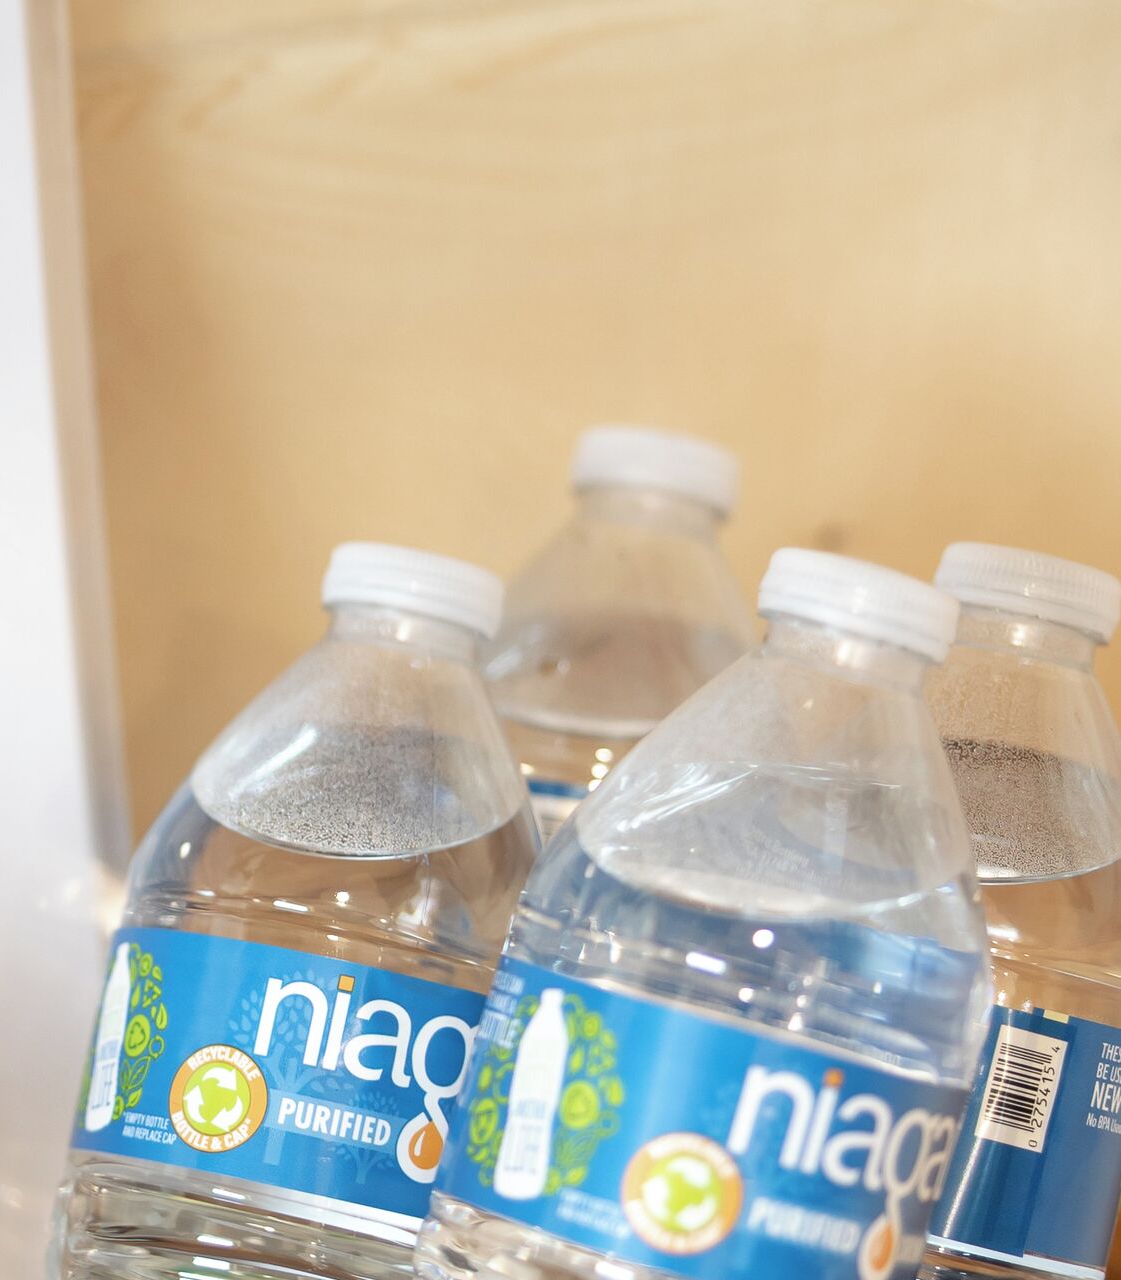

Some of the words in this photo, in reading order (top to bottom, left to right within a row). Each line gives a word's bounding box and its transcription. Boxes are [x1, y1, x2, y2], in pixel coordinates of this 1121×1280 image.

[187, 1045, 261, 1081] RECYCLABLE
[1096, 1062, 1110, 1080] BE
[1090, 1080, 1121, 1114] NEW
[145, 1115, 169, 1131] BOTTLE
[172, 1110, 209, 1149] BOTTLE
[211, 1136, 222, 1150] &
[278, 1097, 392, 1147] PURIFIED
[1086, 1112, 1097, 1128] No
[1097, 1114, 1110, 1131] BPA
[163, 1133, 177, 1145] CAP
